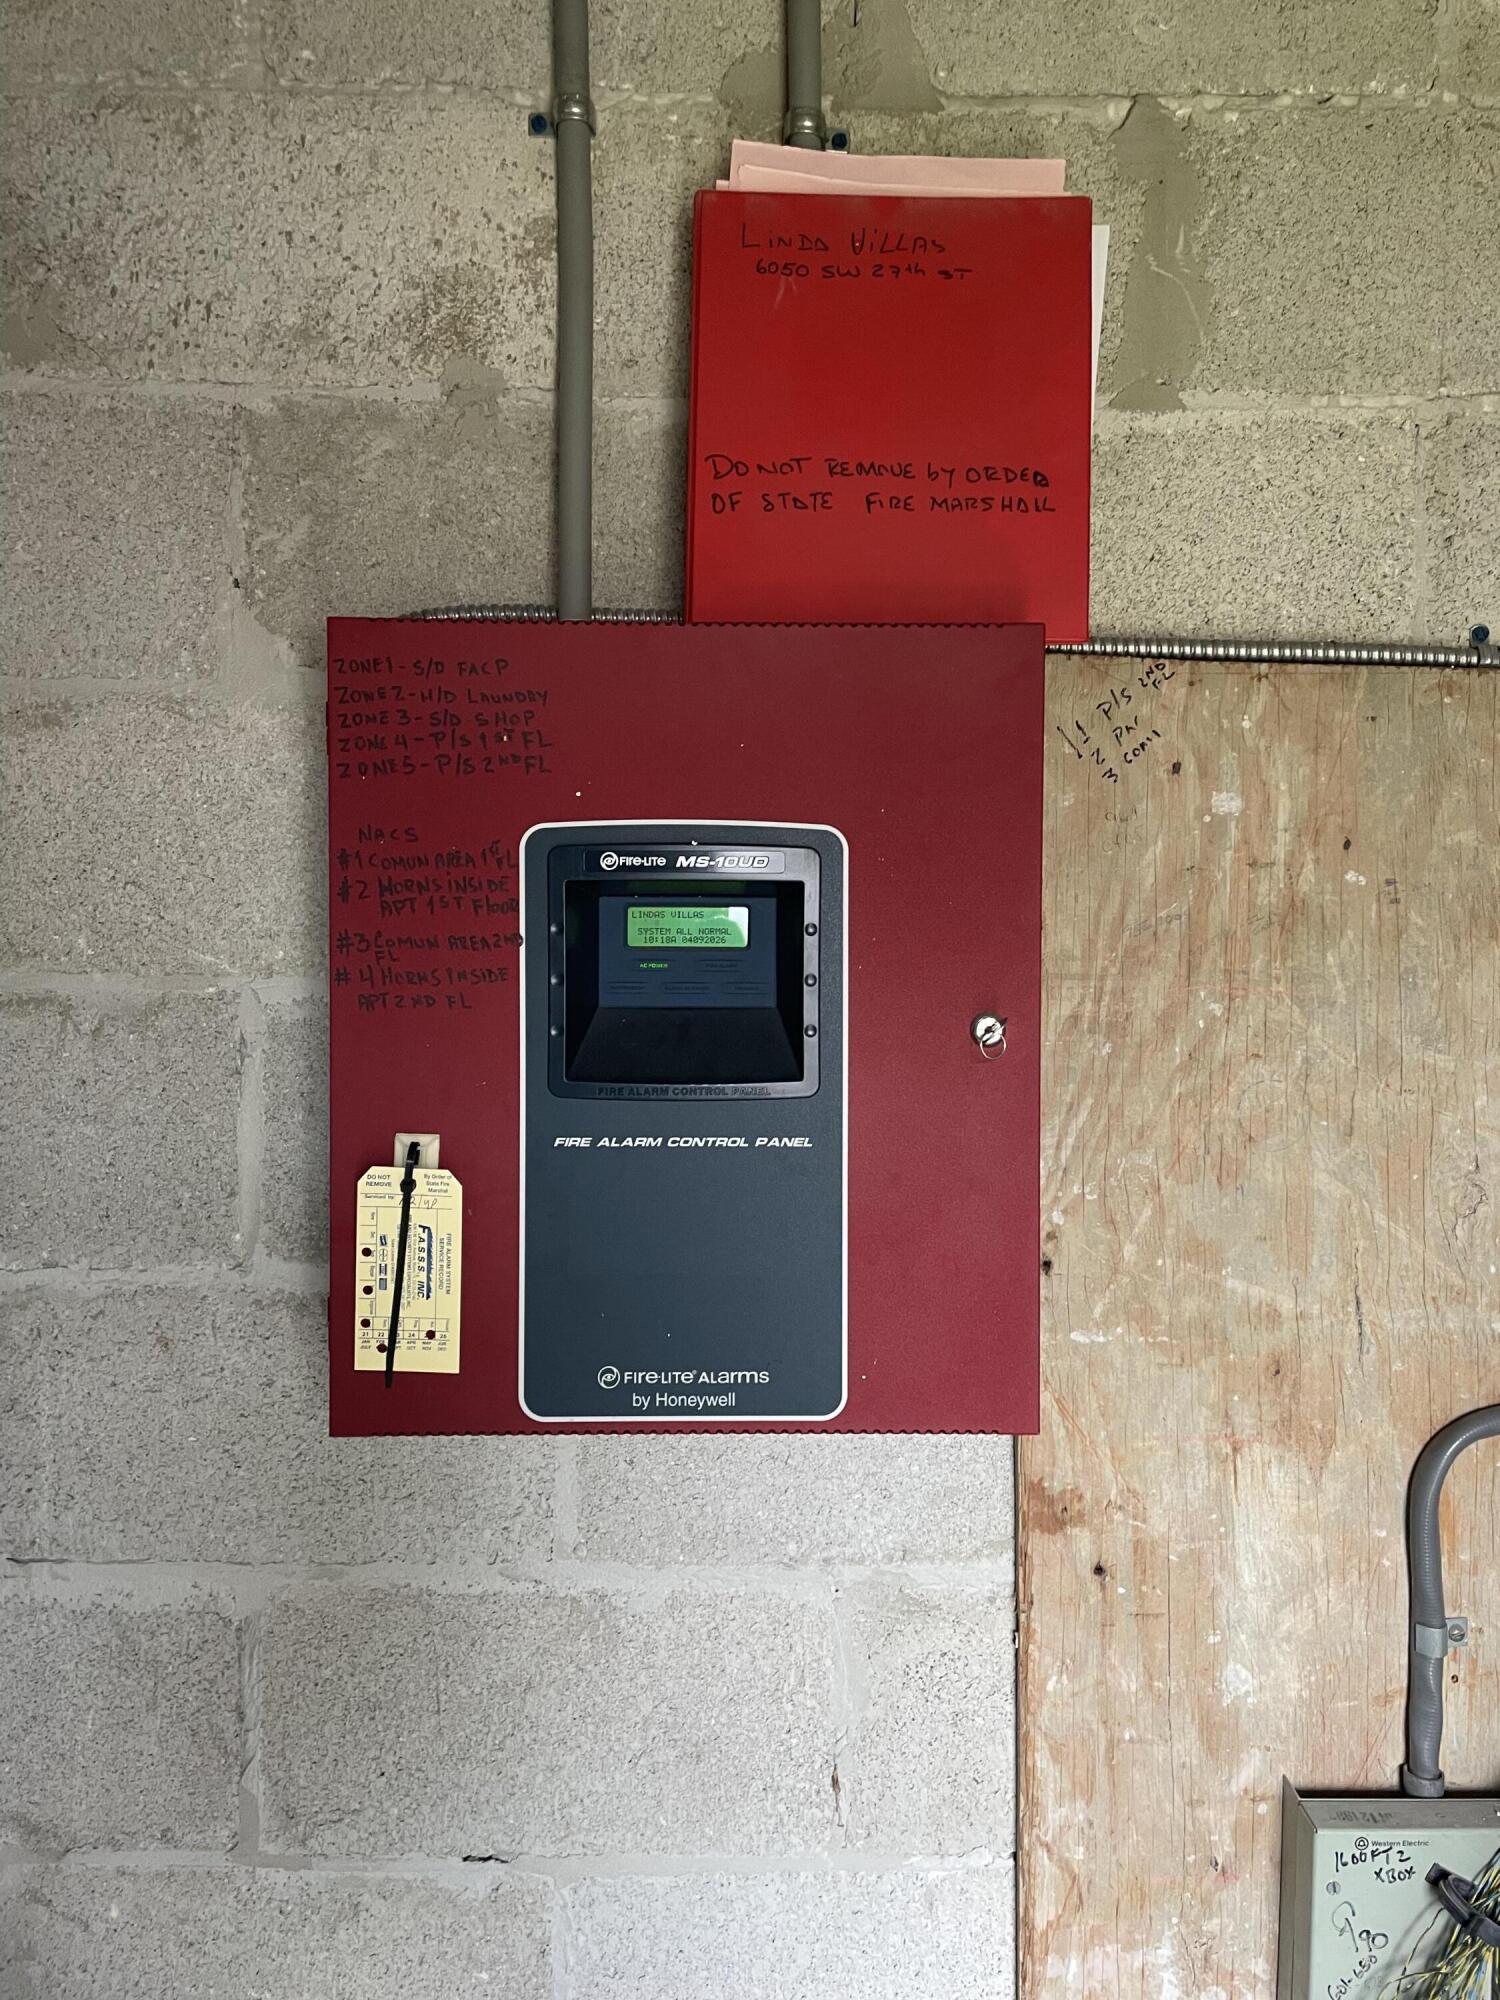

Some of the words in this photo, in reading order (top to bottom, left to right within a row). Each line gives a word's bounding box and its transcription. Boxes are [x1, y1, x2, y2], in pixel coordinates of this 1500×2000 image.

[756, 259, 810, 278] 6050
[822, 264, 861, 279] SW
[872, 262, 925, 278] 27th
[705, 454, 749, 480] DO
[757, 457, 812, 475] NOT
[712, 491, 743, 514] OF
[763, 491, 833, 512] STATE
[467, 688, 548, 707] LAUNDRY
[475, 710, 535, 727] SHOP
[521, 729, 553, 748] FL
[523, 754, 552, 775] FL
[368, 853, 429, 871] COMUN
[435, 850, 476, 870] AREA
[676, 854, 769, 868] MS-10UD
[377, 875, 442, 898] HORNS
[631, 910, 666, 919] LINDAS
[671, 910, 704, 919] VILLAS
[637, 927, 671, 936] SYSTEM
[676, 927, 693, 936] ALL
[698, 927, 732, 936] NORMAL
[643, 935, 677, 944] 10:18A
[681, 936, 727, 944] 04092026
[374, 949, 399, 967] FL
[446, 992, 472, 1009] FL
[597, 1087, 625, 1098] FIRE
[627, 1087, 669, 1097] ALARM
[671, 1086, 729, 1097] CONTROL
[731, 1087, 771, 1096] PANEL
[554, 1137, 592, 1148] FIRE
[597, 1137, 662, 1148] ALARM
[667, 1137, 749, 1148] CONTROL
[754, 1137, 813, 1148] PANEL
[632, 1392, 651, 1410] by
[656, 1392, 736, 1410] Honeywell
[1402, 1839, 1430, 1847] Electric
